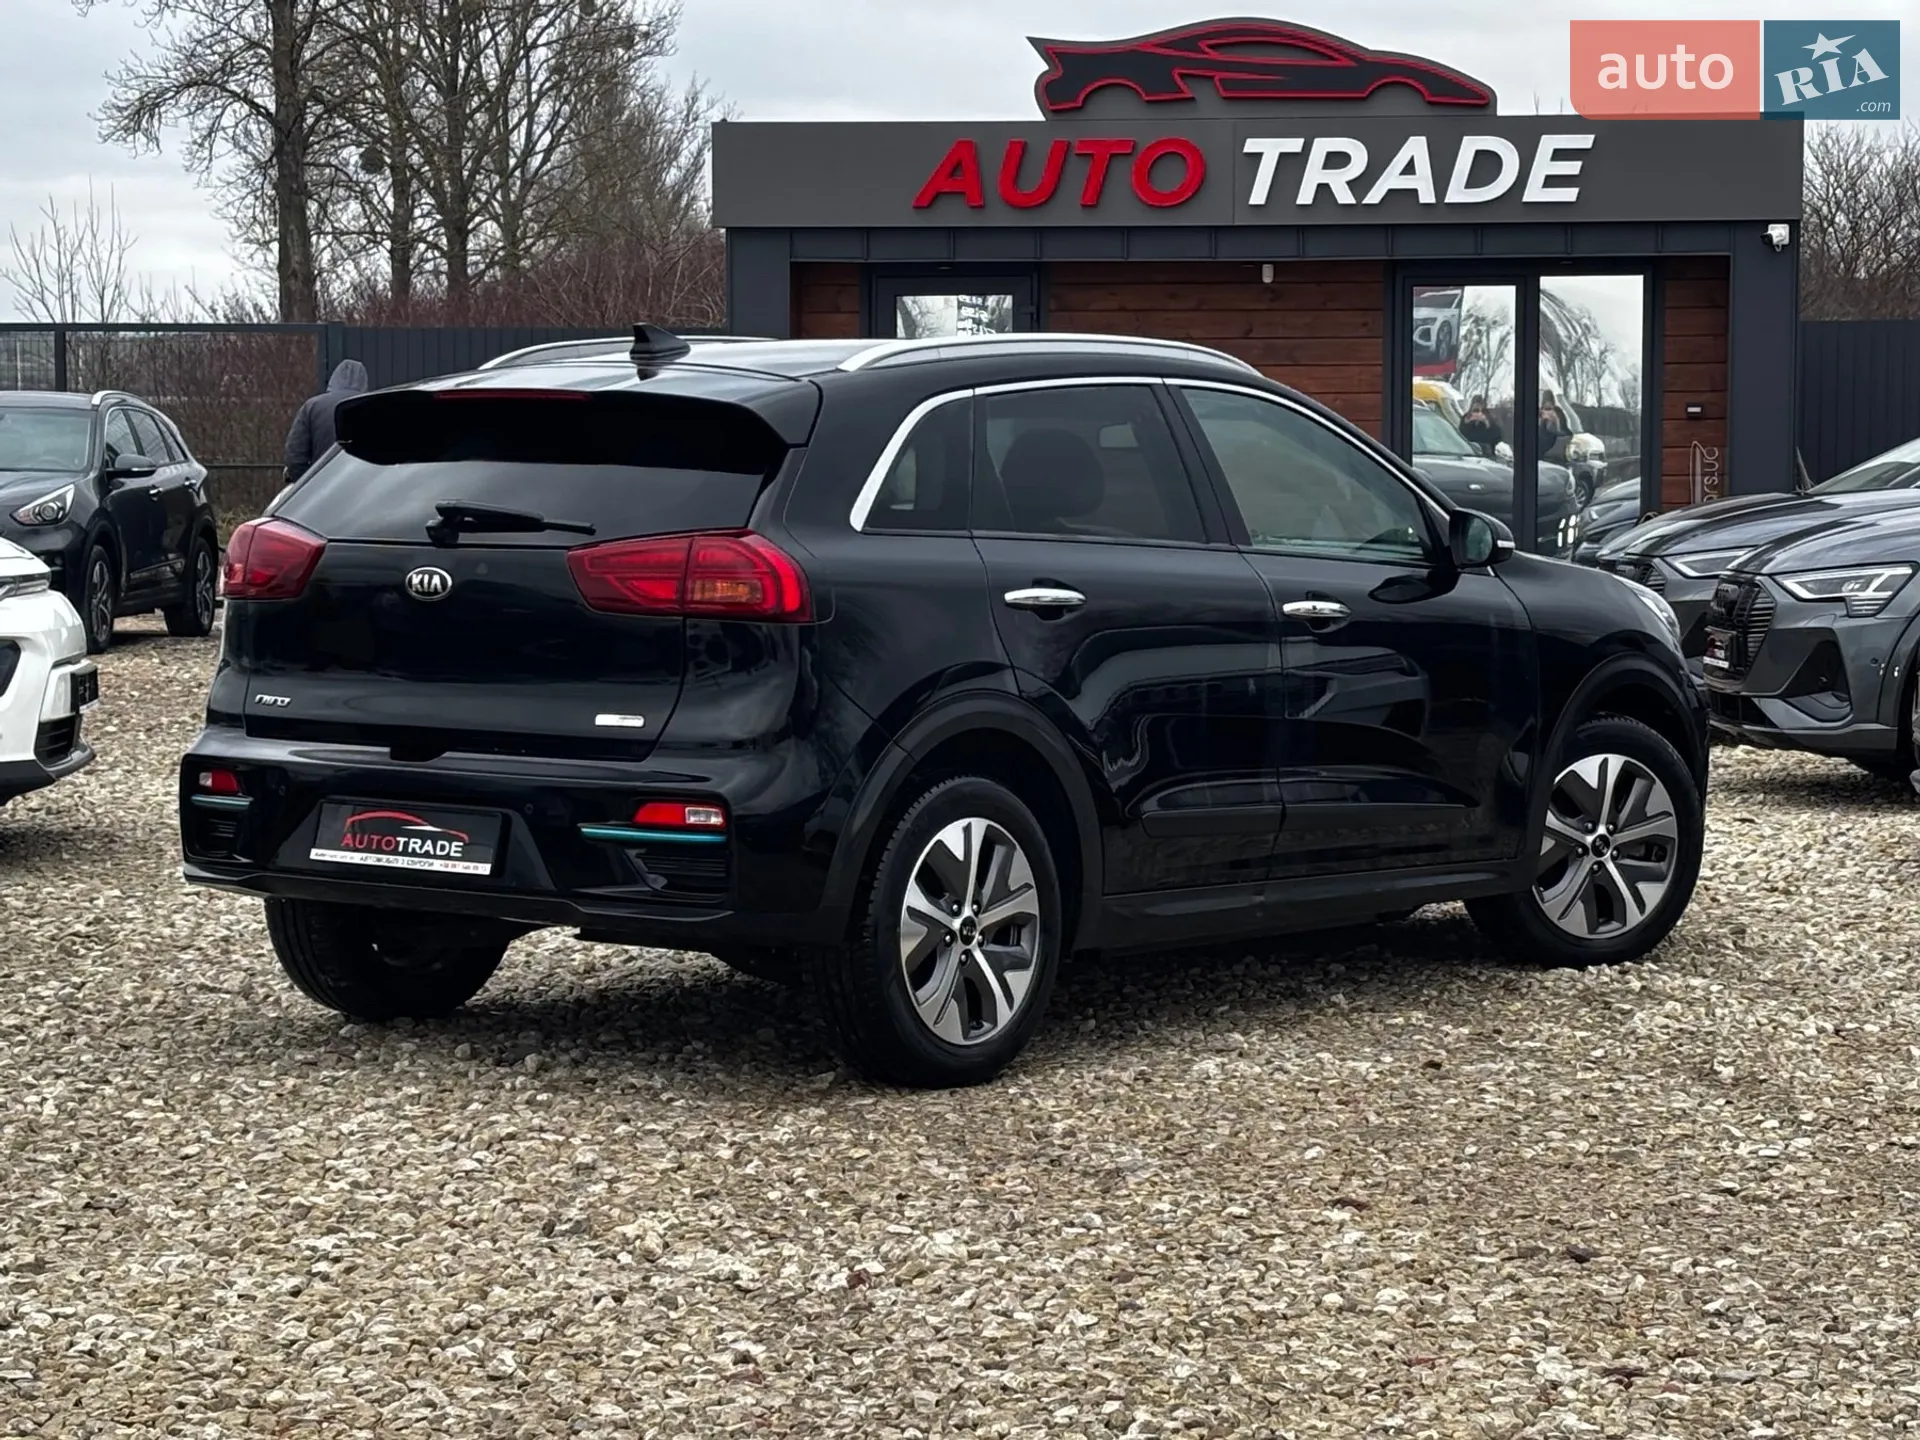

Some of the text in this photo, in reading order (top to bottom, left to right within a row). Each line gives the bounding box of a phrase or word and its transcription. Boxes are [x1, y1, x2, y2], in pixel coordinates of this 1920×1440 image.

[913, 134, 1595, 209] AUTO TRADE
[411, 573, 443, 593] KIA
[341, 833, 464, 857] AUTOTRADE
